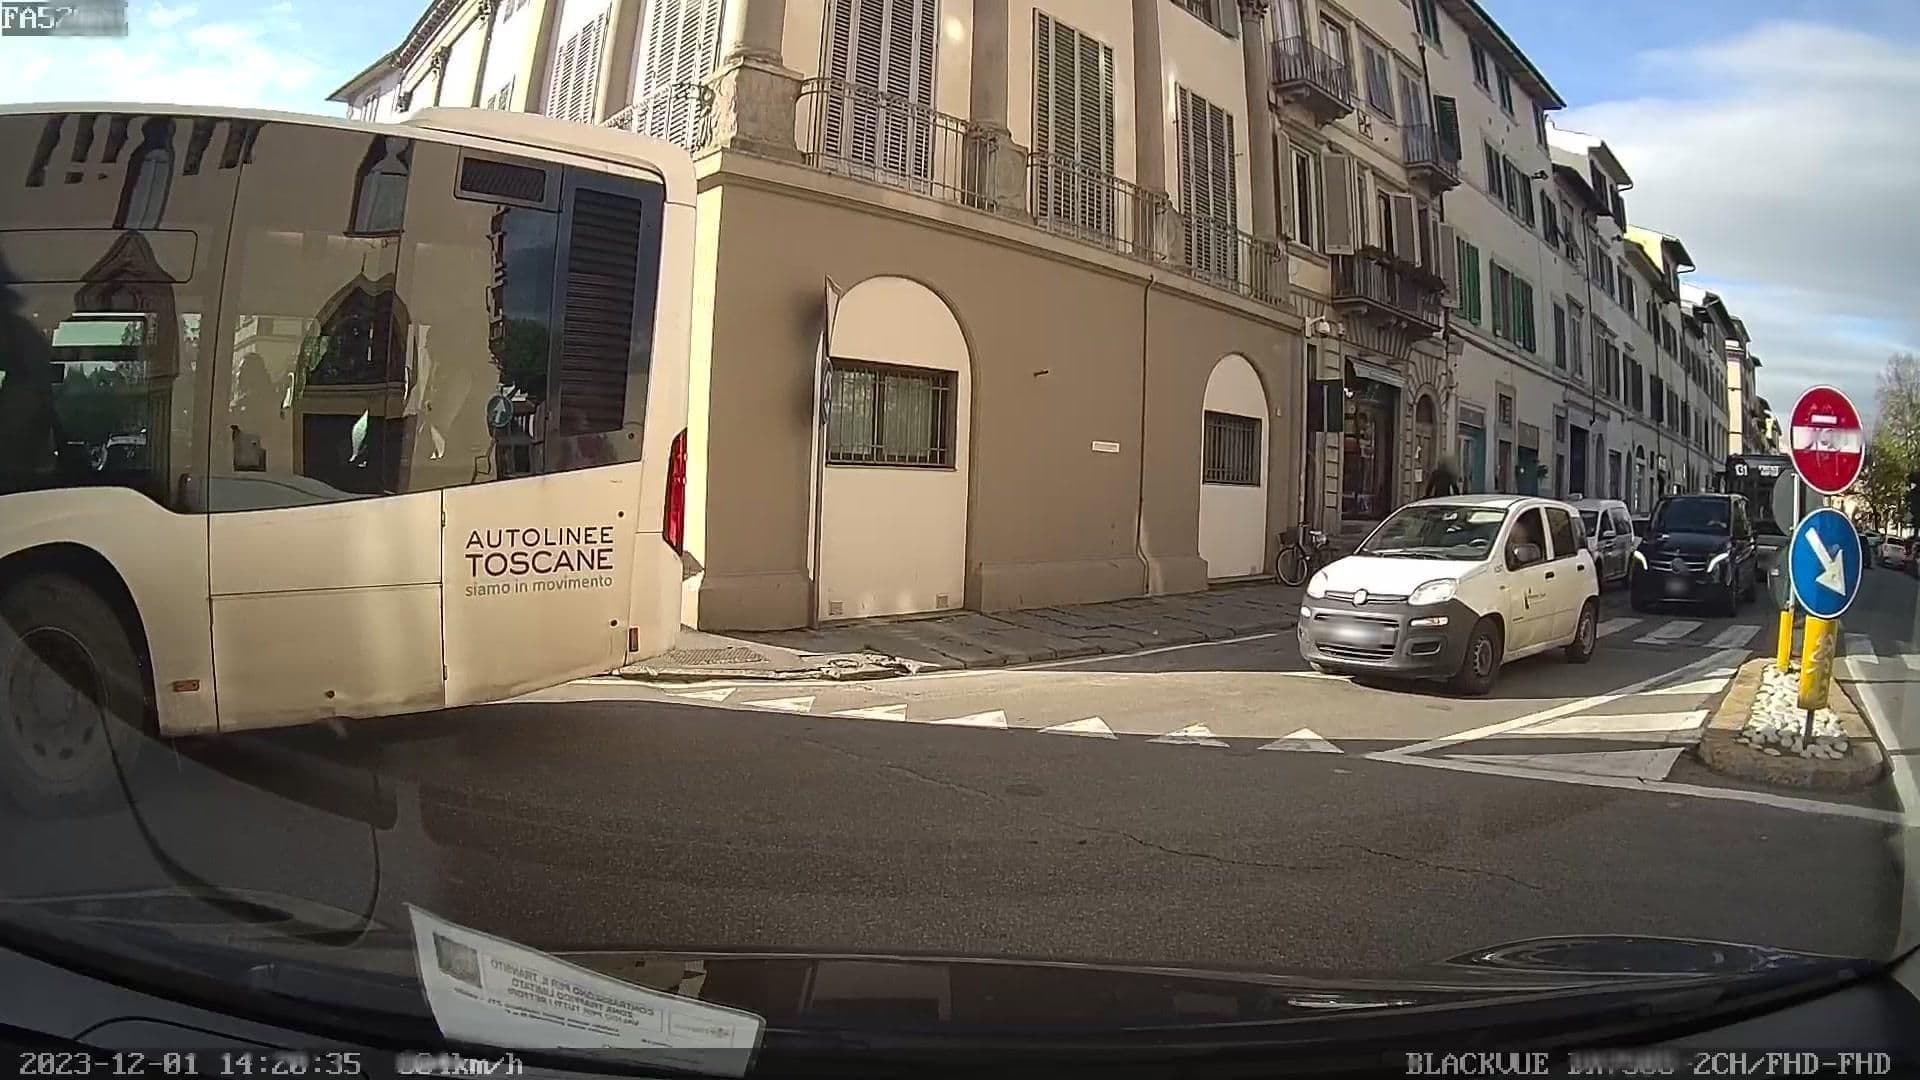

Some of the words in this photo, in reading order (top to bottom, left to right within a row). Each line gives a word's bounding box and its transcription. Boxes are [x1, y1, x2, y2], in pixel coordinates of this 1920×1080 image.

[465, 526, 614, 549] AUTOLINEE
[465, 548, 614, 577] TOSCANE
[465, 583, 511, 597] siamo
[515, 579, 528, 593] in
[532, 575, 614, 593] movimento
